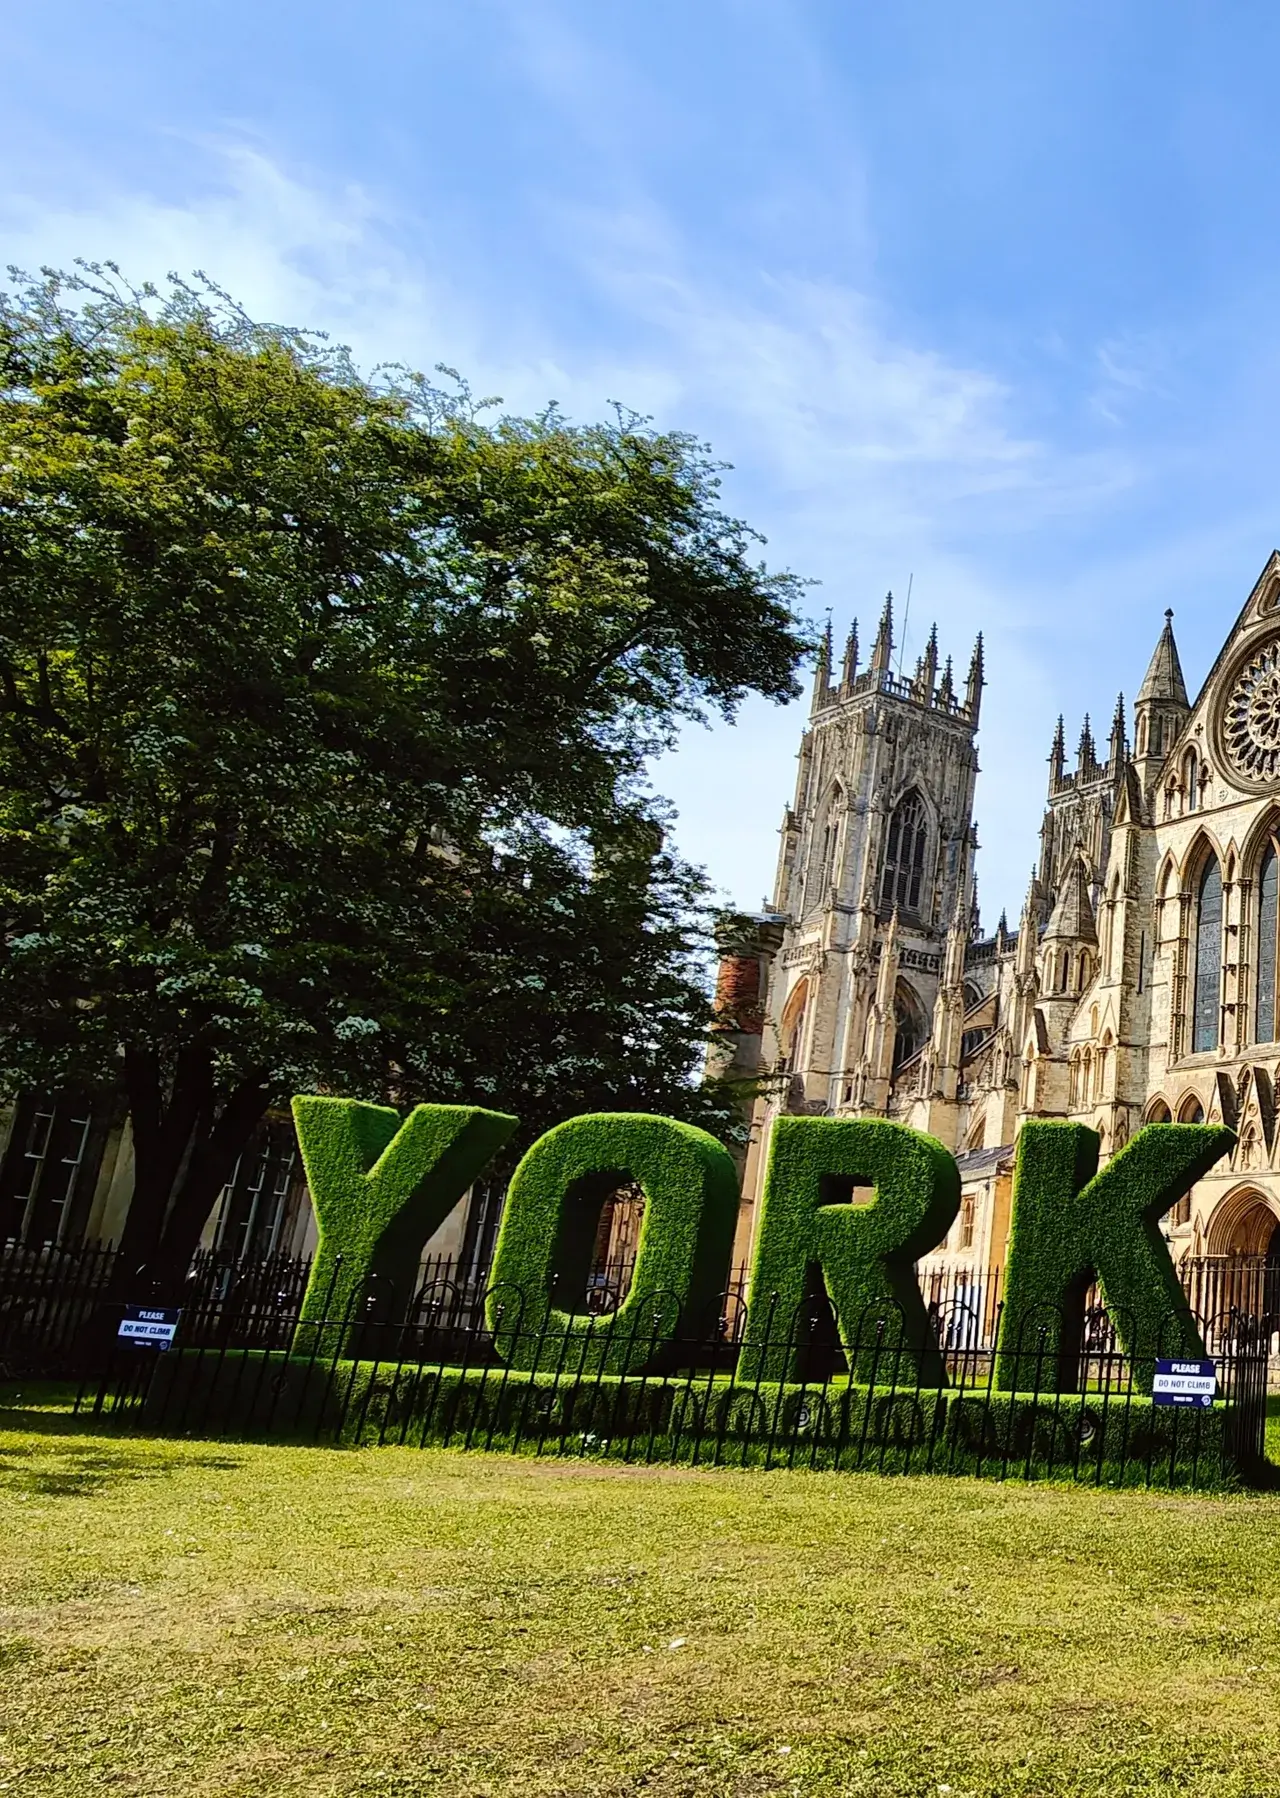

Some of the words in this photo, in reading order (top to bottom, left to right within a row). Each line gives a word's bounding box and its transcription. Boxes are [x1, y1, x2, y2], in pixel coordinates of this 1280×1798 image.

[291, 1094, 1237, 1394] YORK
[138, 1310, 165, 1321] PLEASE
[123, 1324, 133, 1332] DO
[134, 1325, 148, 1333] NOT
[149, 1326, 171, 1336] CLIMB
[1171, 1363, 1201, 1374] PLEASE
[1158, 1379, 1169, 1388] DO
[1170, 1380, 1185, 1389] NOT
[1187, 1380, 1211, 1390] CLIMB
